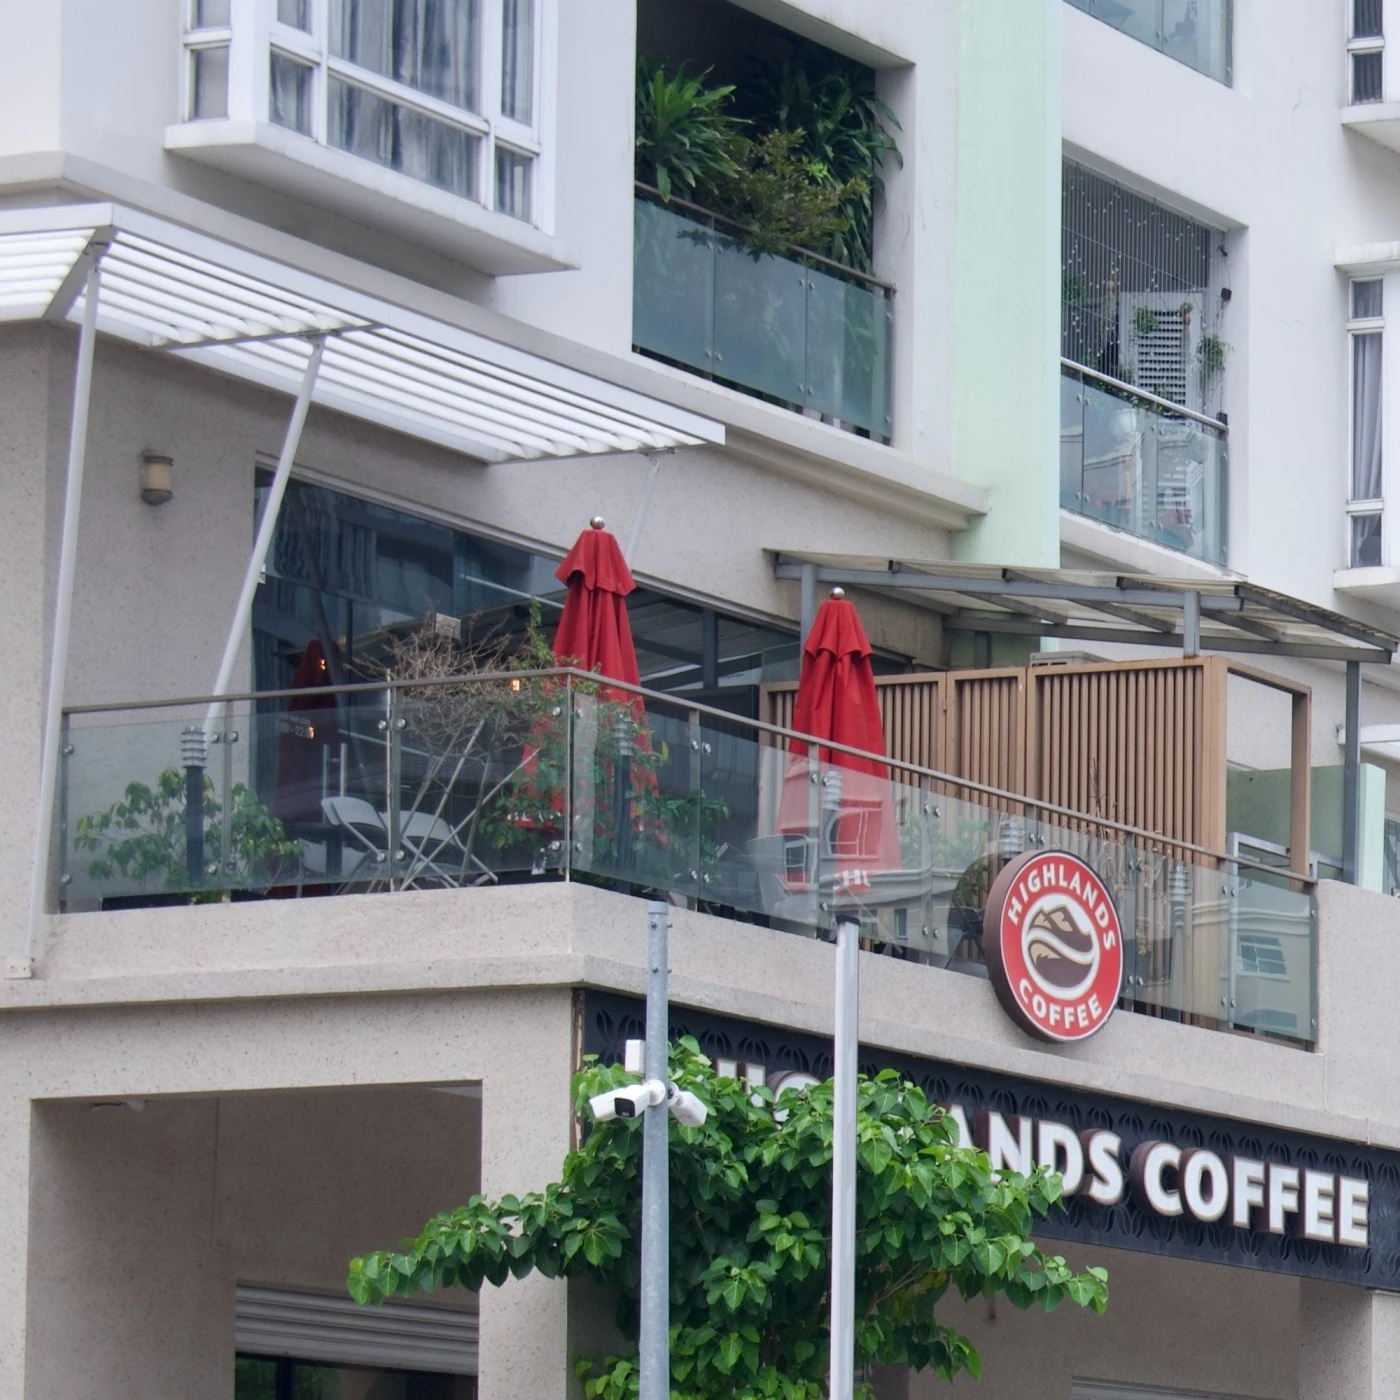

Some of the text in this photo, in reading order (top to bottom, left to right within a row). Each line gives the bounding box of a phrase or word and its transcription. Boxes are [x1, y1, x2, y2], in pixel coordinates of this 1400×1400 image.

[1007, 863, 1117, 951] HIGHLANDS
[1019, 978, 1103, 1030] COFFEE
[1144, 1142, 1369, 1247] COFFEE
